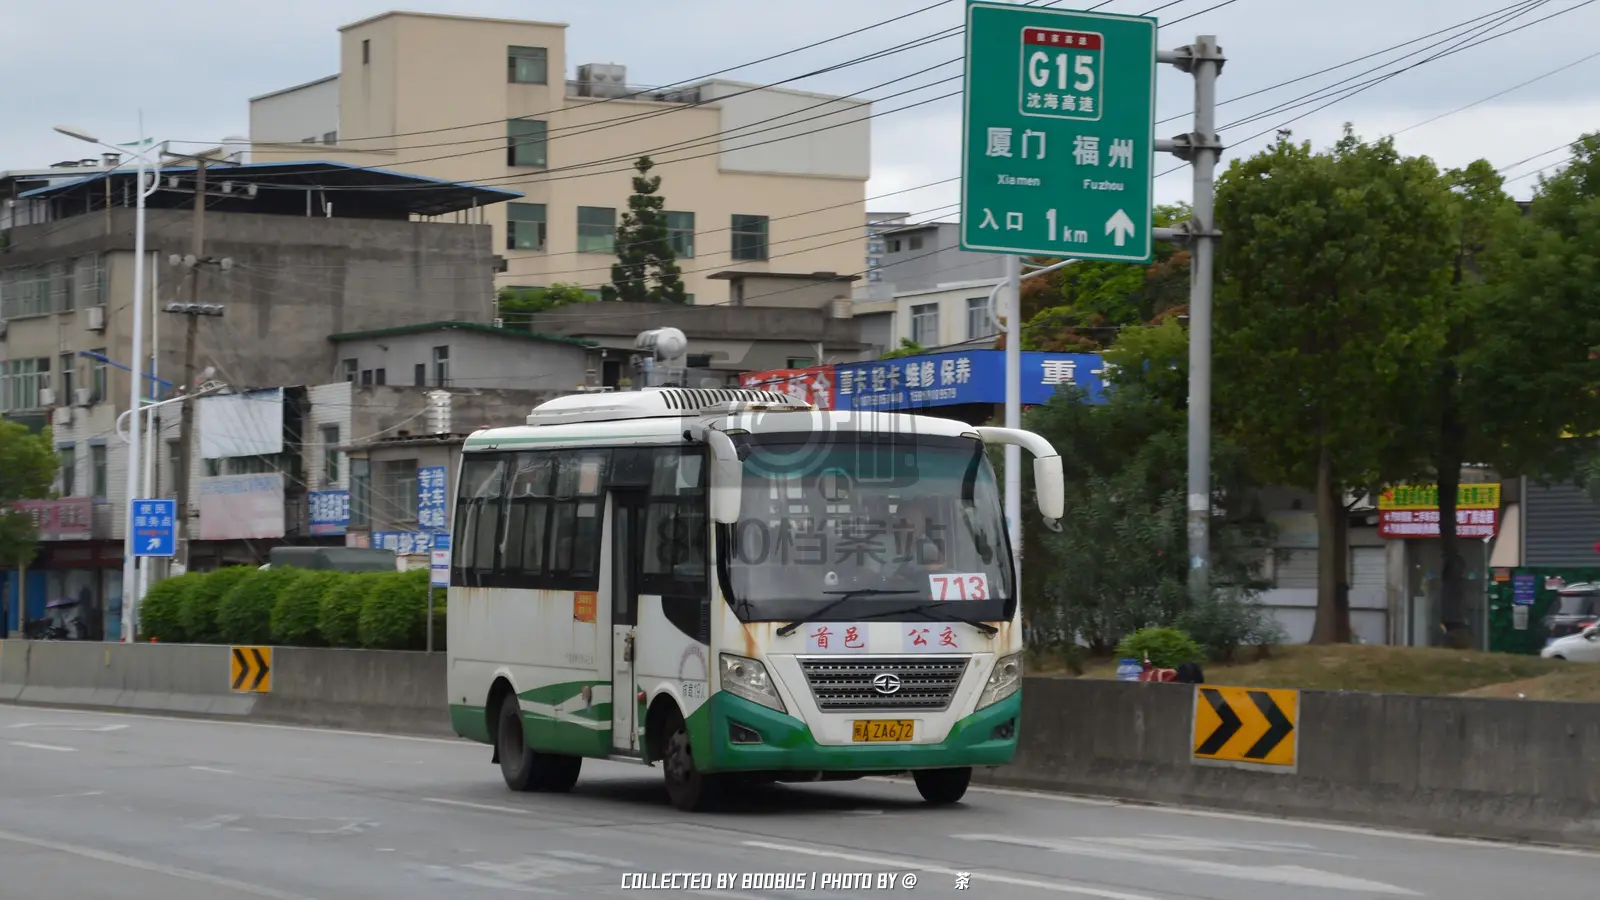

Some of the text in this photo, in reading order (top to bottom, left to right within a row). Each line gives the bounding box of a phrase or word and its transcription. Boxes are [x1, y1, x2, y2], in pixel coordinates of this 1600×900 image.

[1028, 50, 1096, 92] G15
[1026, 92, 1095, 113] 沈海高速
[985, 126, 1134, 169] 厦门 福州
[997, 174, 1124, 192] Xiamen Fuzhou
[978, 207, 1089, 244] 入口 1 km
[932, 575, 987, 600] 713
[810, 626, 960, 649] 首邑 公交
